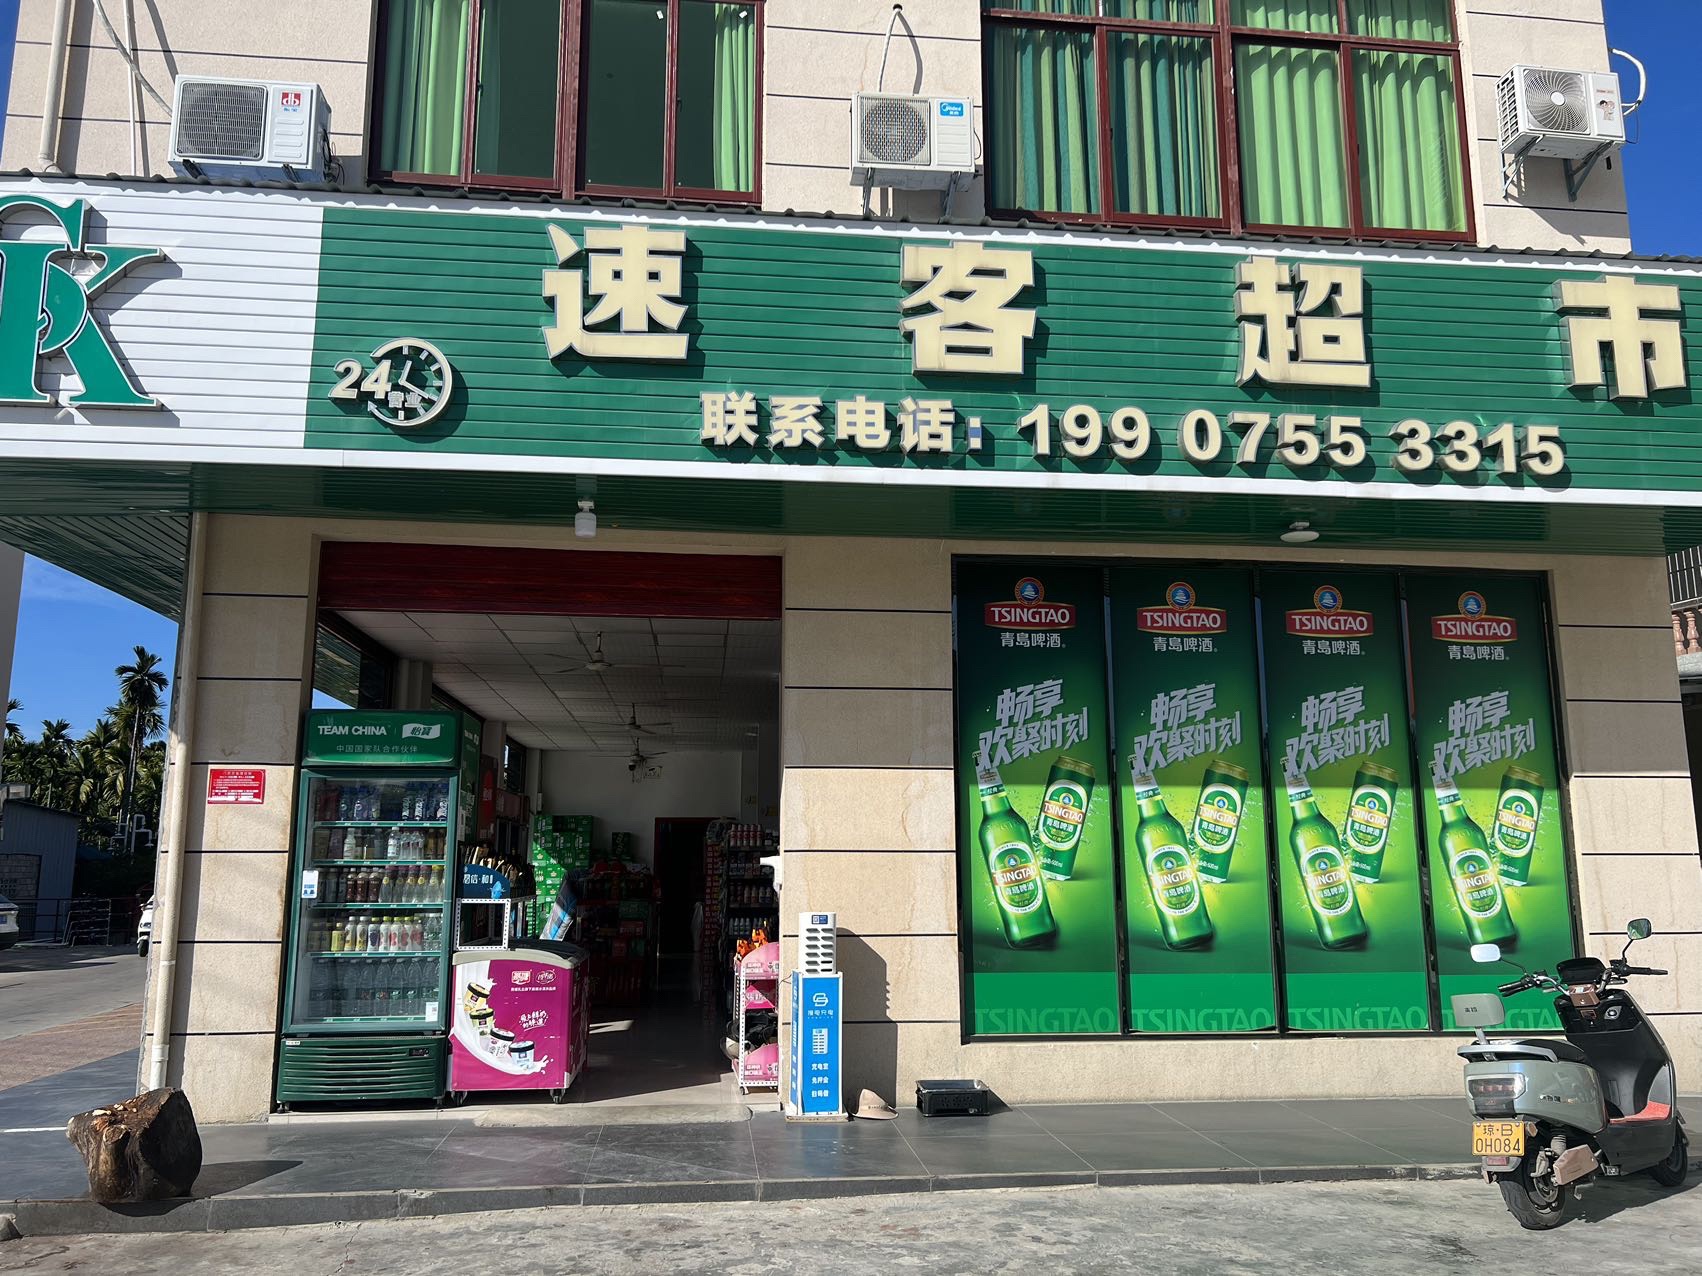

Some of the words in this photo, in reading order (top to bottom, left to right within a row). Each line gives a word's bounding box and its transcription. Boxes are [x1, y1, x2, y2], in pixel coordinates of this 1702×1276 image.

[541, 224, 1687, 400] 速客超市
[328, 358, 392, 399] 24
[1016, 404, 1151, 460] 199
[1178, 409, 1367, 467] 0755
[1389, 419, 1565, 476] 3315
[990, 607, 1070, 624] TSINGTAO
[1142, 612, 1222, 628] TSINGTAO
[1291, 615, 1368, 631] TSINGTAO
[1437, 621, 1512, 637] TSINGTAO
[996, 679, 1064, 728] 畅享
[1150, 683, 1217, 732] 畅享
[1301, 686, 1366, 734] 畅享
[1448, 691, 1511, 738] 畅享
[317, 725, 349, 736] TEAM
[351, 725, 388, 736] CHINA
[979, 706, 1088, 771] 欢聚时刻
[1133, 711, 1241, 776] 欢聚时刻
[1285, 713, 1390, 779] 欢聚时刻
[1433, 718, 1536, 781] 欢聚时刻
[1043, 803, 1084, 823] TSINGTAO
[1200, 806, 1237, 825] TSINGTAO
[1351, 808, 1388, 827] TSINGTAO
[974, 1007, 1116, 1033] TSINGTAO
[1131, 1007, 1272, 1032] TSINGTAO
[1287, 1007, 1429, 1030] TSINGTAO
[1475, 1137, 1521, 1153] 0H084
